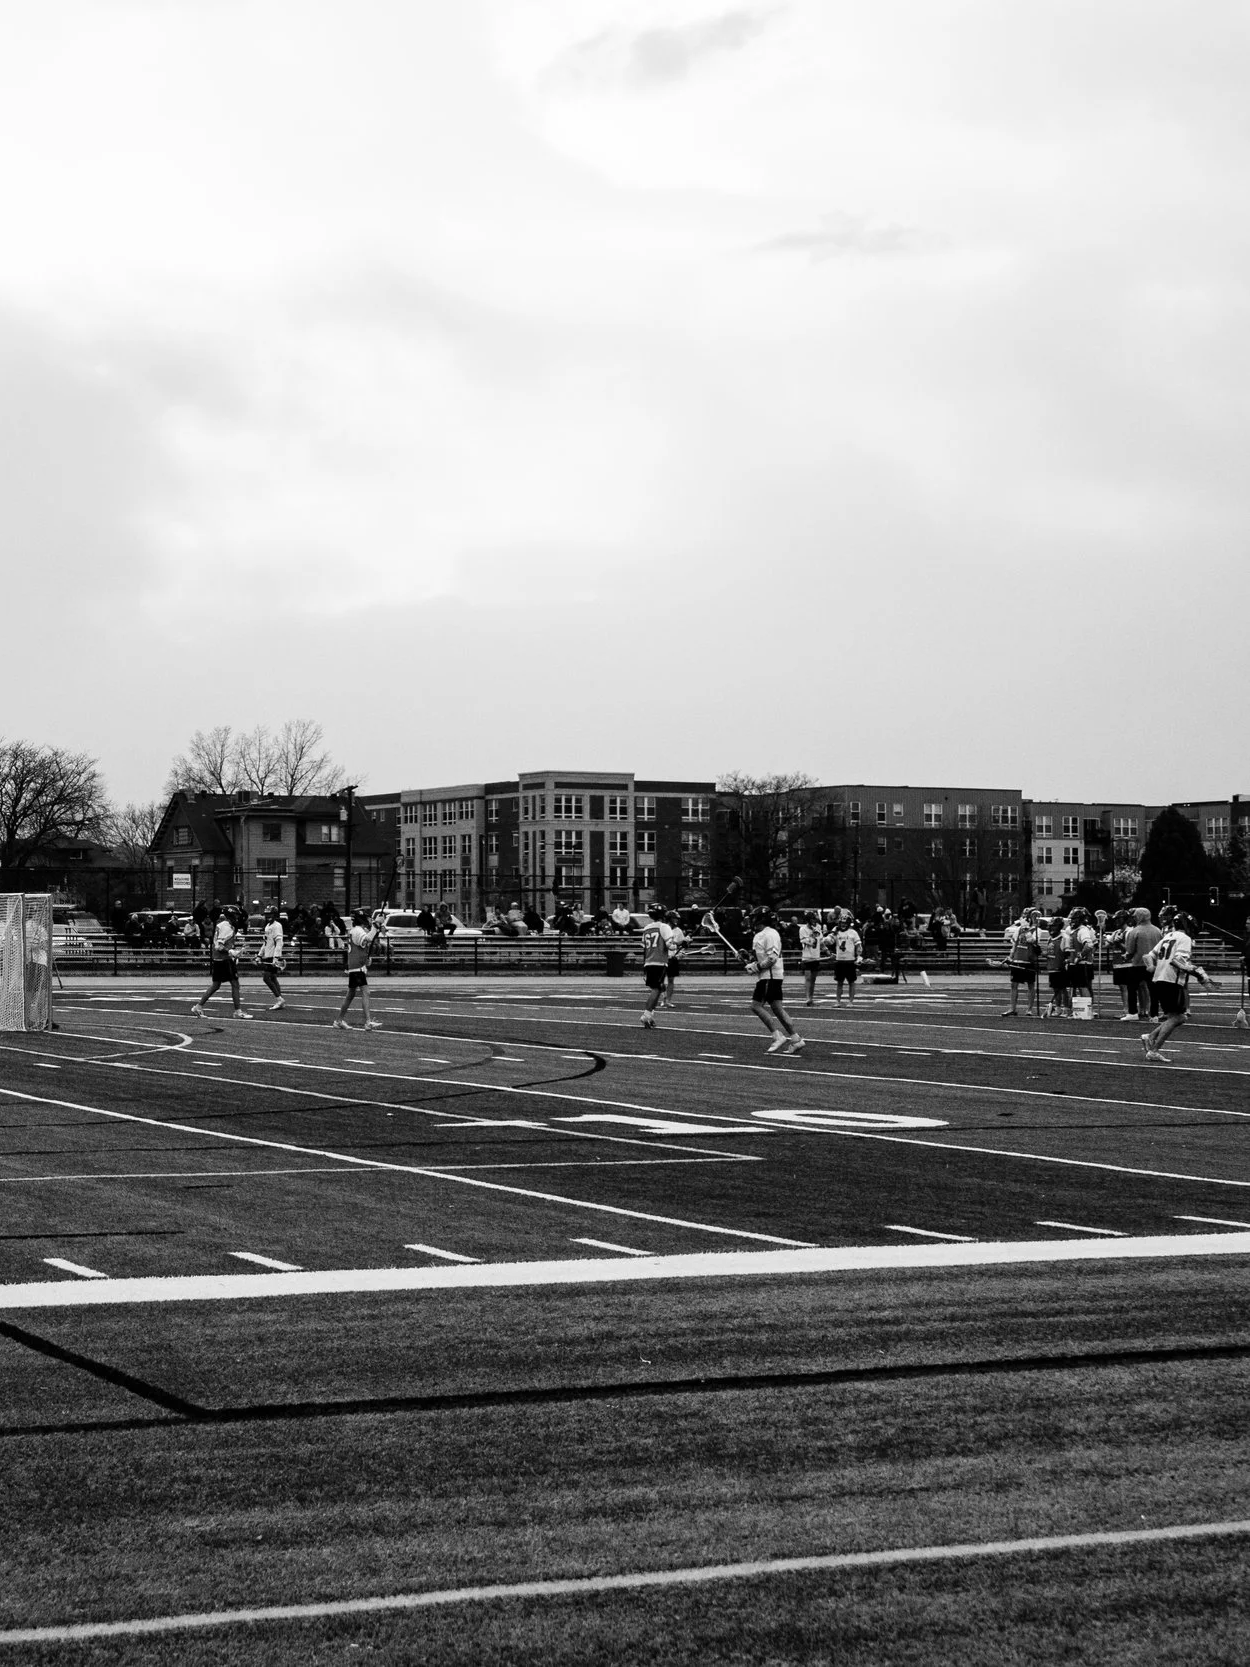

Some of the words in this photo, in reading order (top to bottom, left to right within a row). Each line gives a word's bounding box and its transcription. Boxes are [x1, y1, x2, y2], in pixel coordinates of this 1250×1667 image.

[645, 932, 659, 949] 67
[839, 940, 846, 952] 4
[550, 1110, 950, 1134] 10
